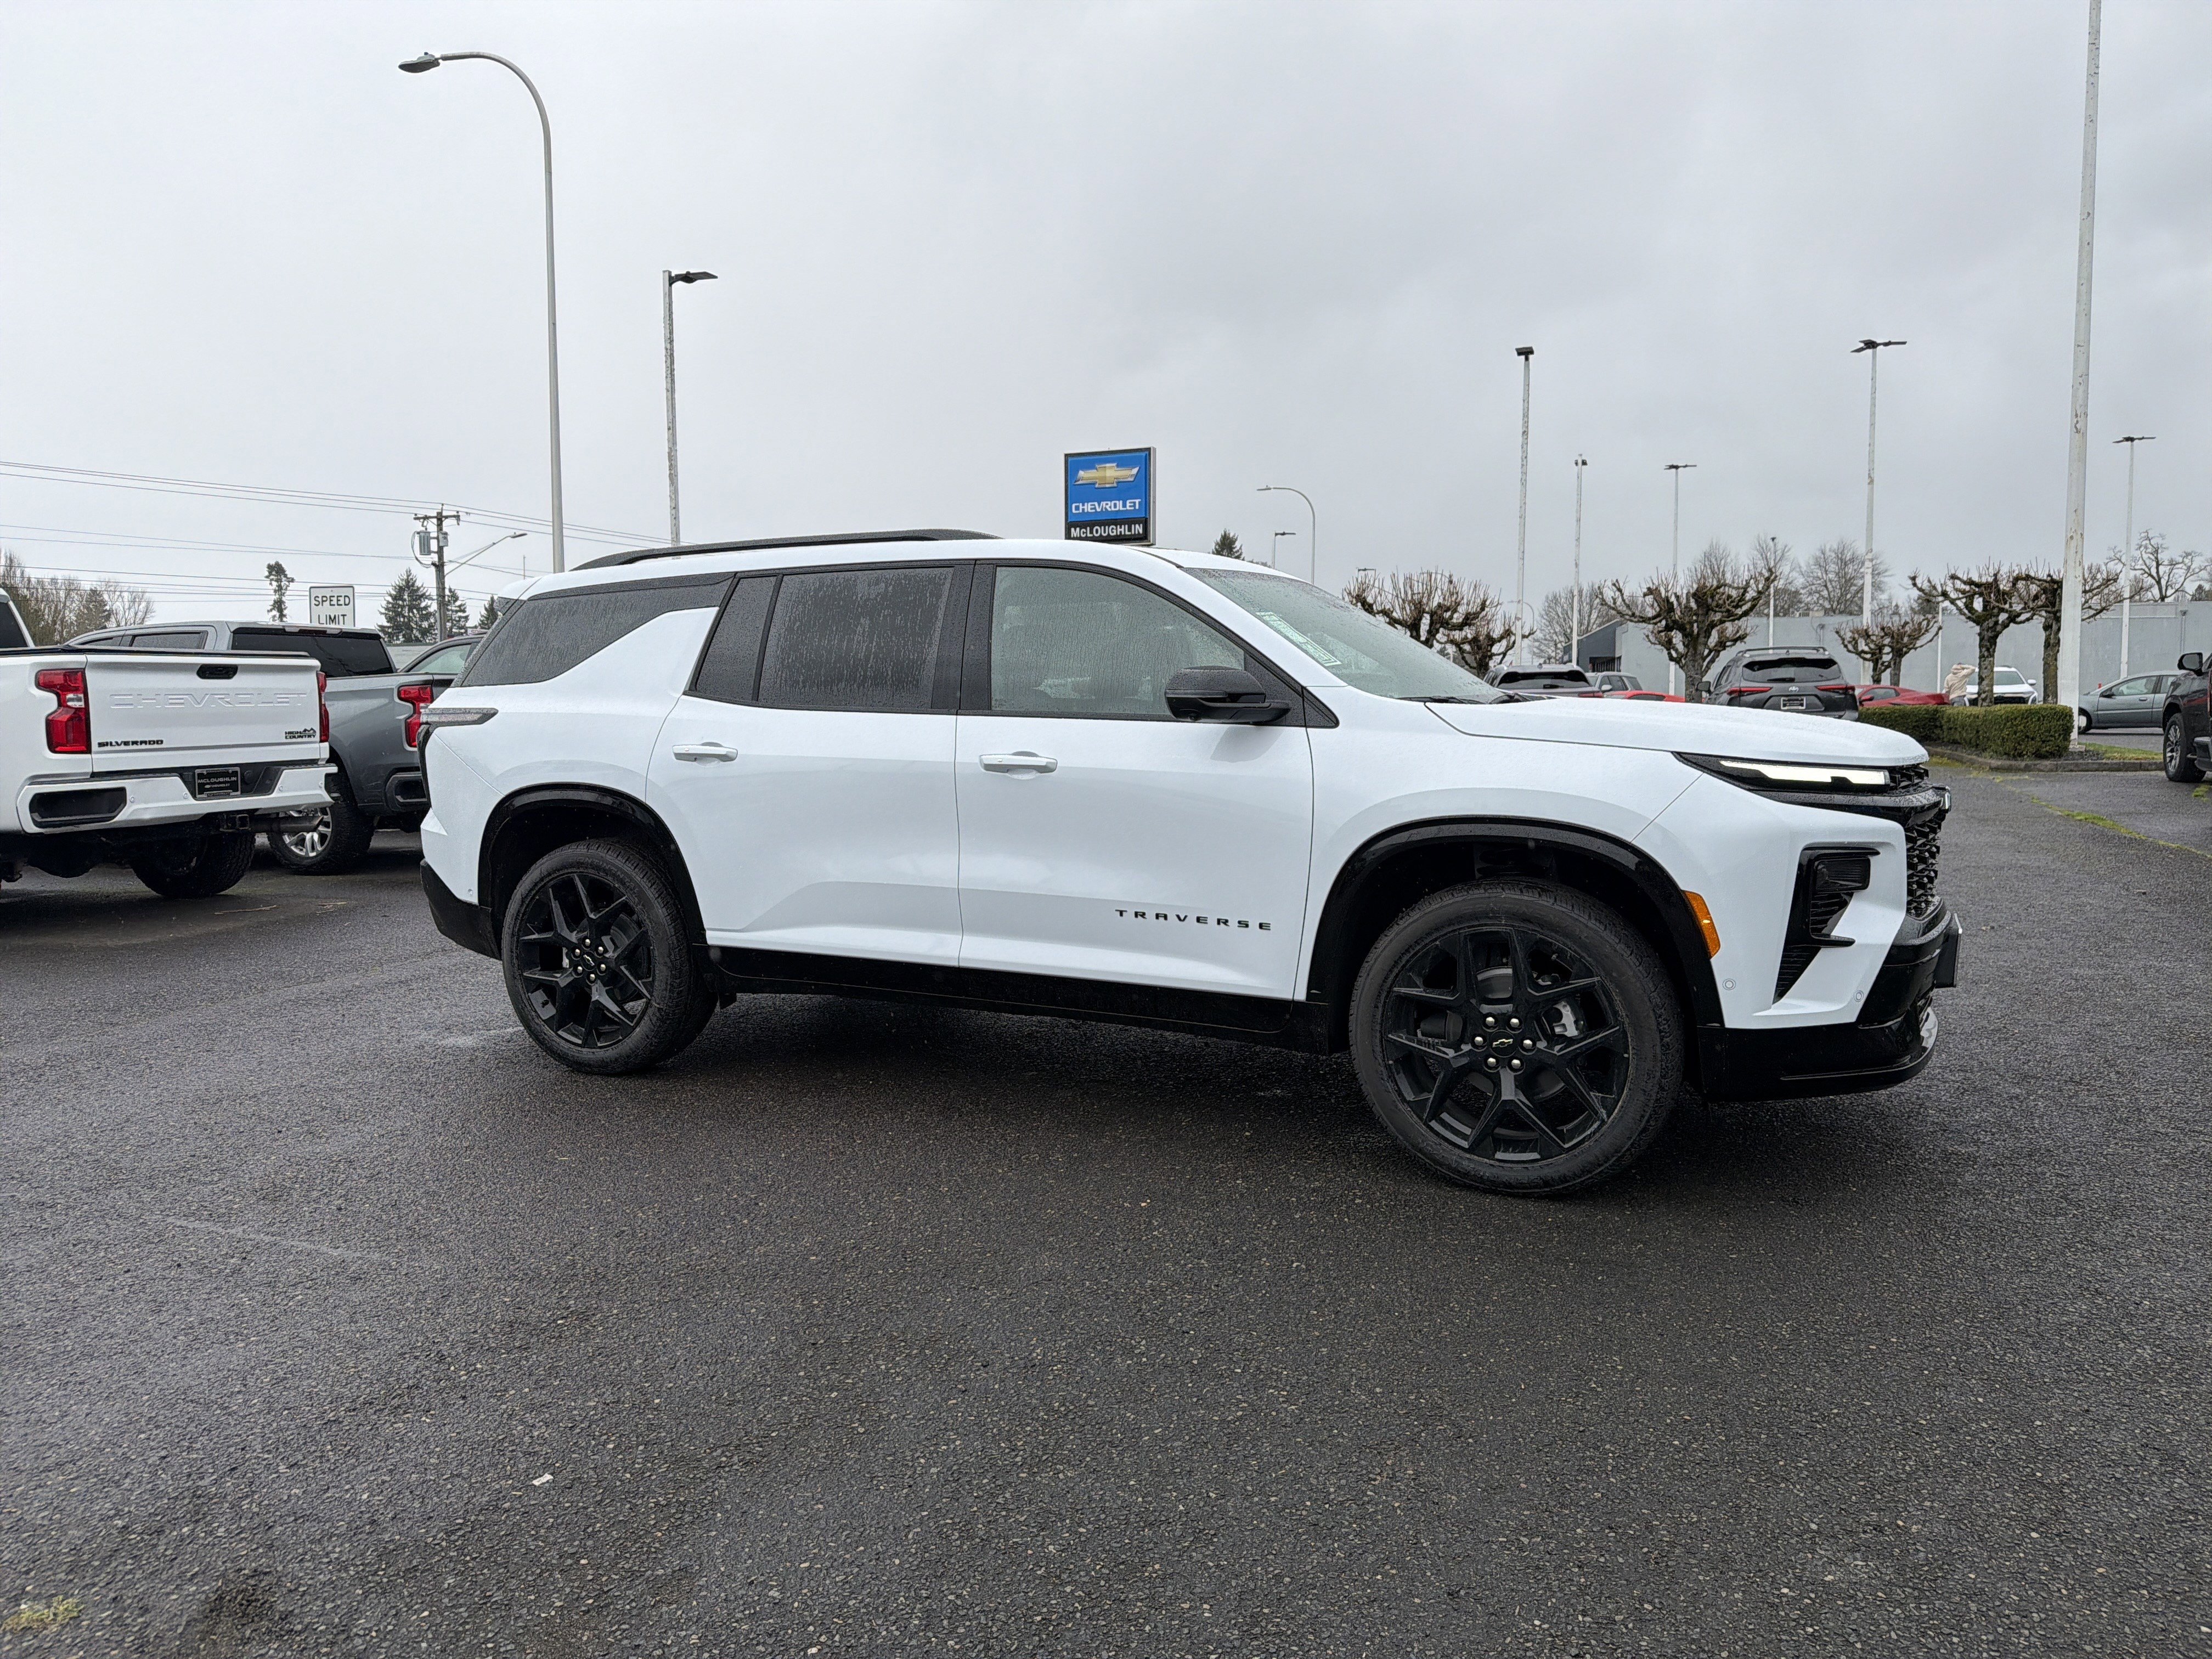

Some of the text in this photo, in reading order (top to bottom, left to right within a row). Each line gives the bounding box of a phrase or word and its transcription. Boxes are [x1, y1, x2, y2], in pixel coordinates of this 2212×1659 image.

[1072, 499, 1141, 514] CHEVROLET
[1070, 523, 1143, 538] McLOUGHLIN
[313, 595, 351, 607] SPEED
[318, 614, 347, 625] LIMIT
[110, 693, 307, 709] CHEVROLET
[97, 739, 164, 748] SILVERADO
[1115, 909, 1272, 931] TRAVERSE
